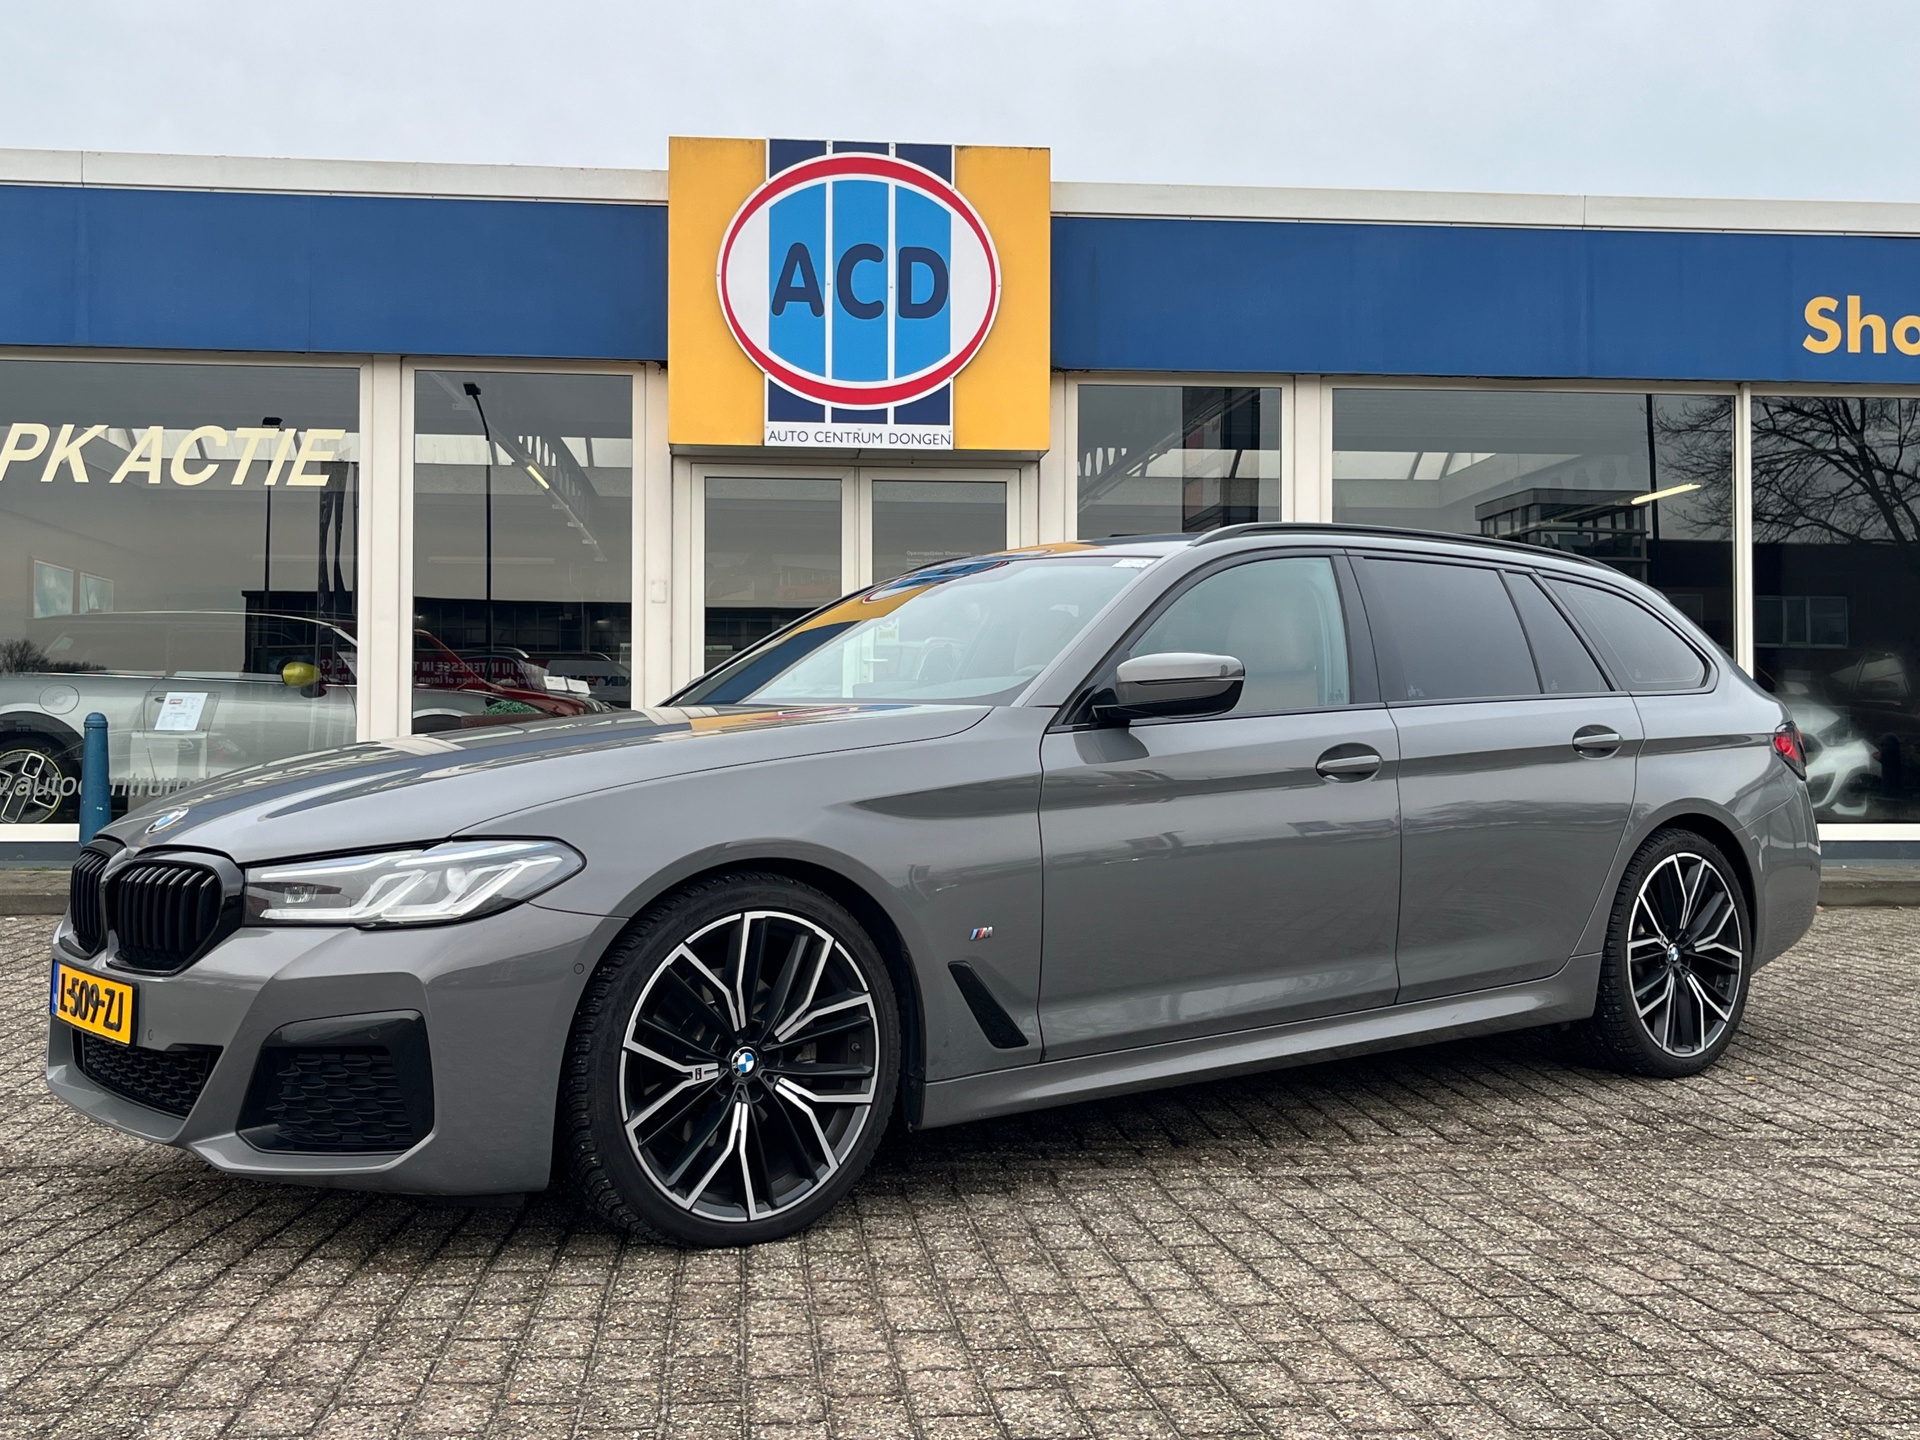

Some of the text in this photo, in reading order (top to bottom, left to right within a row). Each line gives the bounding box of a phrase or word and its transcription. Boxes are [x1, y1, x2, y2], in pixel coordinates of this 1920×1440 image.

[771, 242, 949, 320] ACD
[1802, 295, 1920, 356] Sho
[0, 423, 346, 486] PK ACTIE
[768, 430, 951, 446] AUTO CENTRUM DONGEN
[60, 973, 124, 1032] L-509-ZJ
